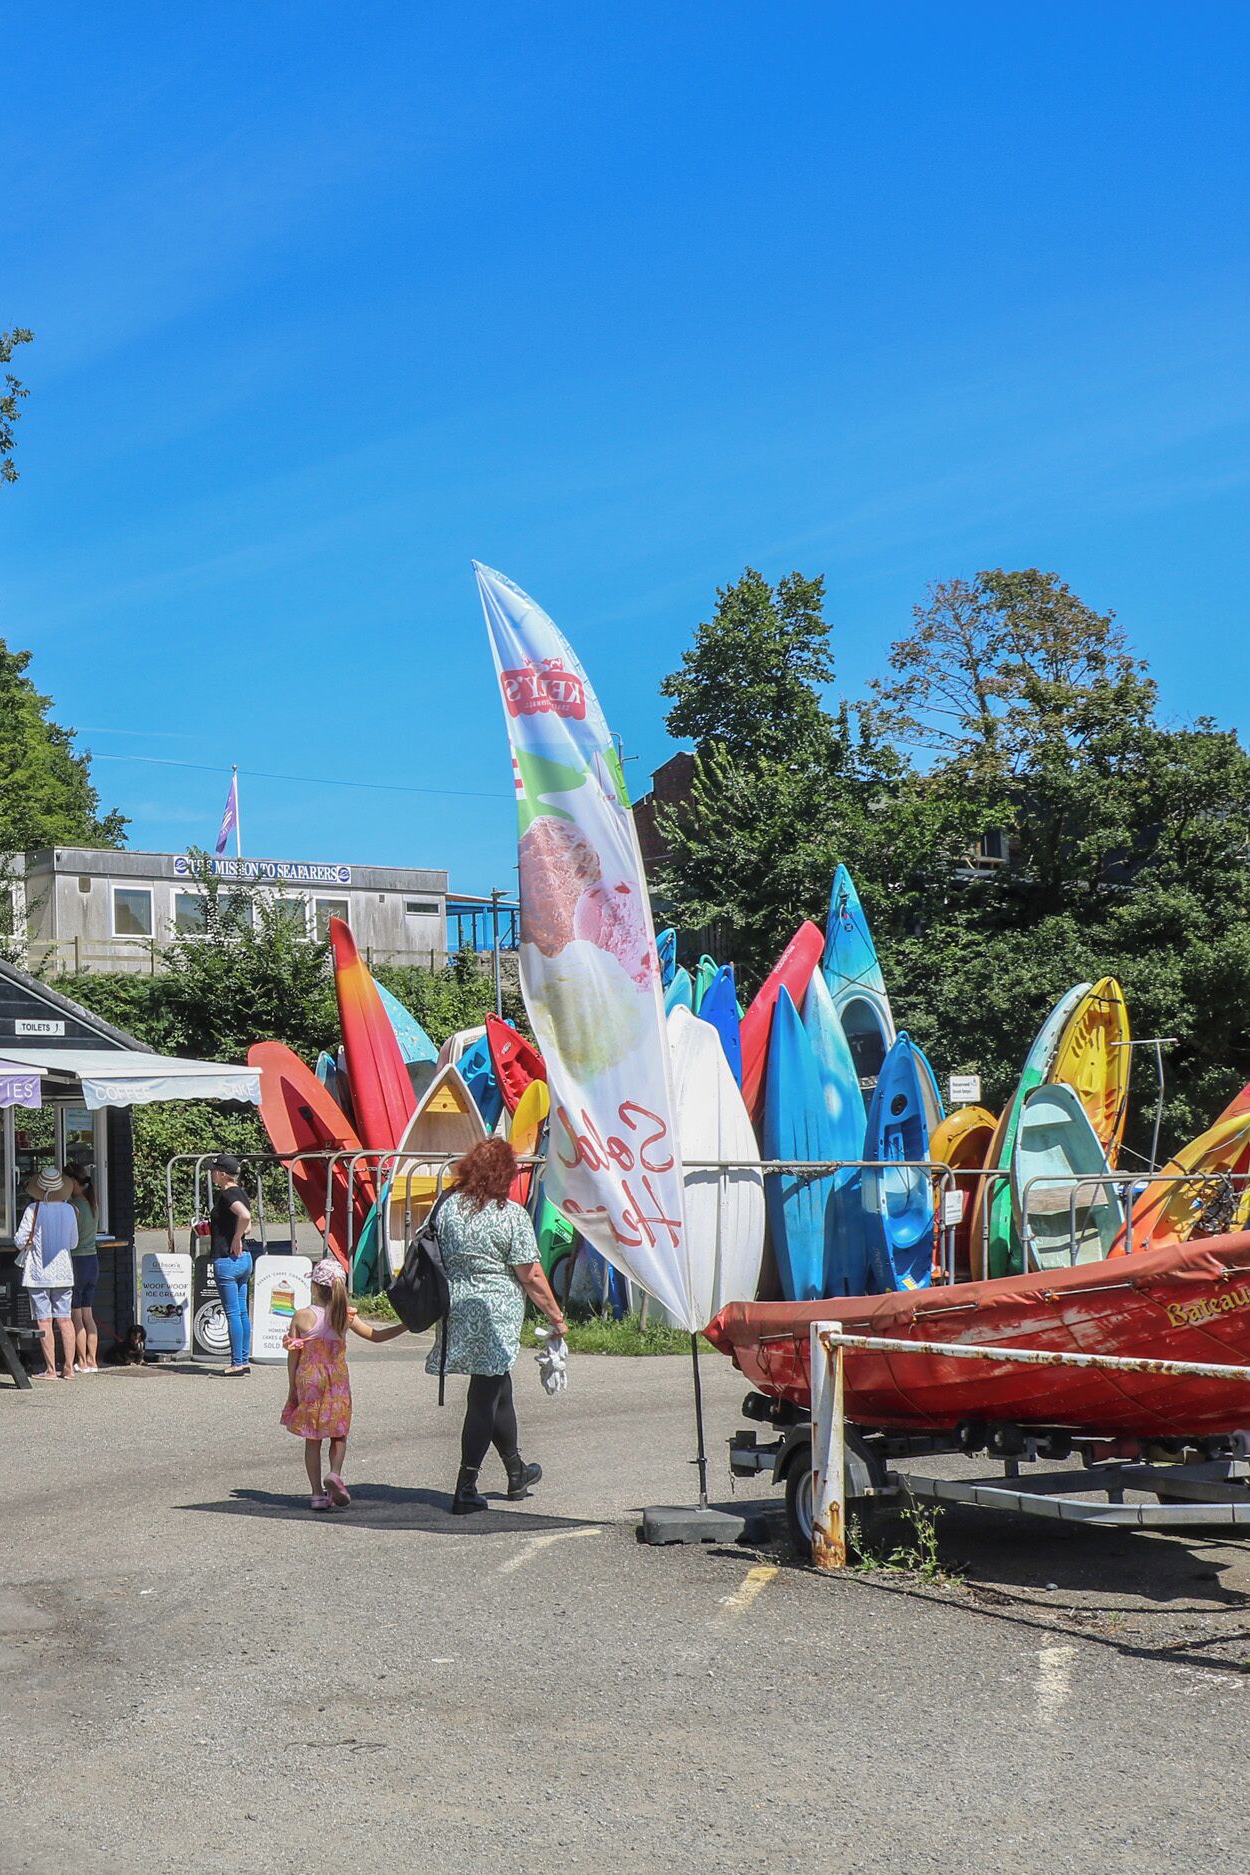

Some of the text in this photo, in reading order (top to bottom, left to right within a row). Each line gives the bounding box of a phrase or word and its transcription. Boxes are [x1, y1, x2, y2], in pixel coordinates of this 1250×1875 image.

[260, 863, 275, 878] TO
[277, 864, 337, 882] SEAFARERS
[21, 1023, 51, 1032] TOILETS
[95, 1084, 256, 1101] COFFEE CAKE
[263, 1342, 280, 1350] SOLD
